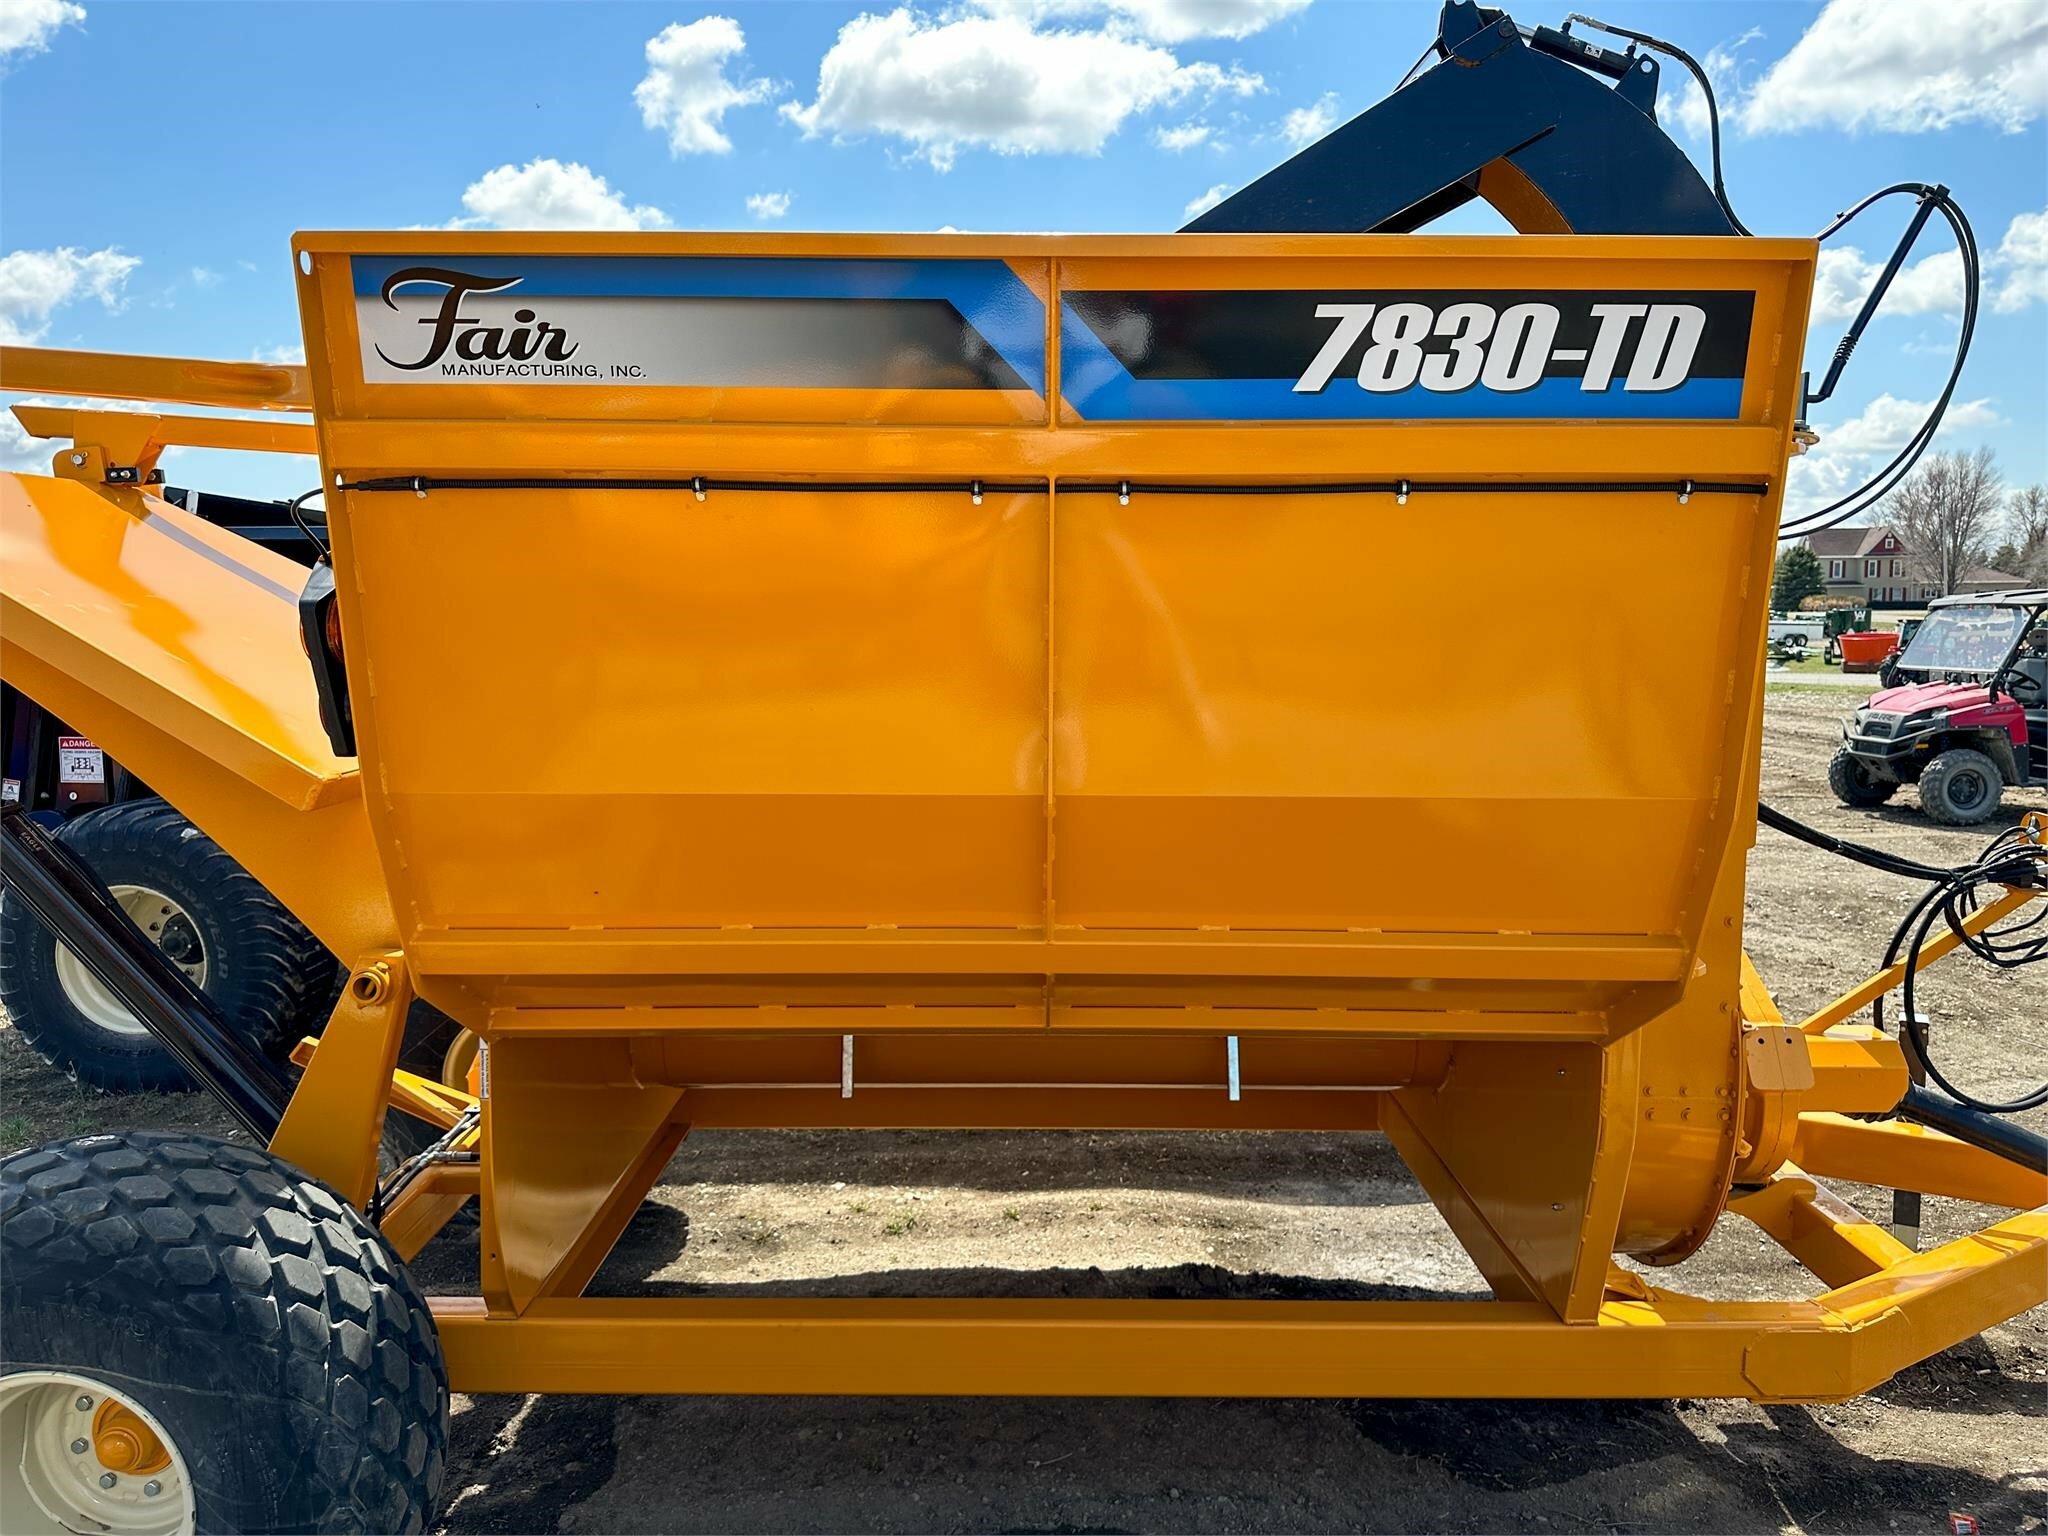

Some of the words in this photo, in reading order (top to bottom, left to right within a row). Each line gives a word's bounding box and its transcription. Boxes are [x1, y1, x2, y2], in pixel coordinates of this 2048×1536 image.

[375, 267, 579, 370] Fair
[442, 364, 603, 379] MANUFACTURING,
[610, 365, 647, 378] INC.
[1292, 303, 1708, 393] 7830-TD
[69, 740, 96, 748] DANGE
